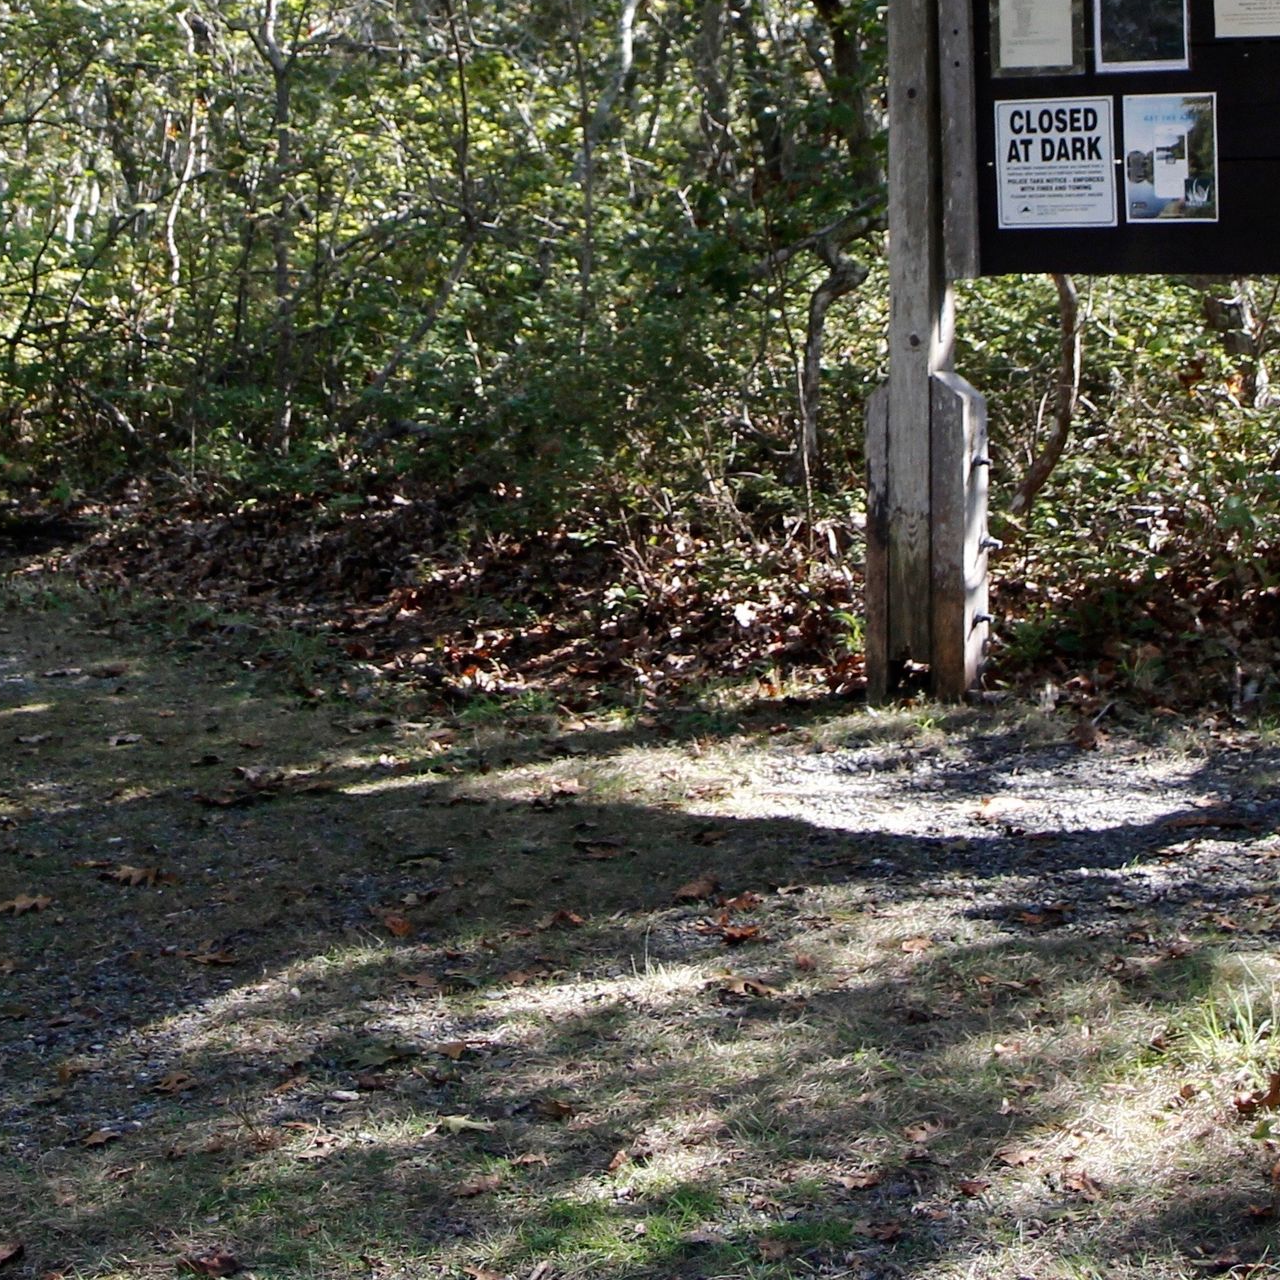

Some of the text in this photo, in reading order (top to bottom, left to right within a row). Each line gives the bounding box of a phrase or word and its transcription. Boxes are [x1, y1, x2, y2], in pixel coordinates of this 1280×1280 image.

[1010, 107, 1098, 134] CLOSED
[1007, 136, 1102, 163] AT DARK
